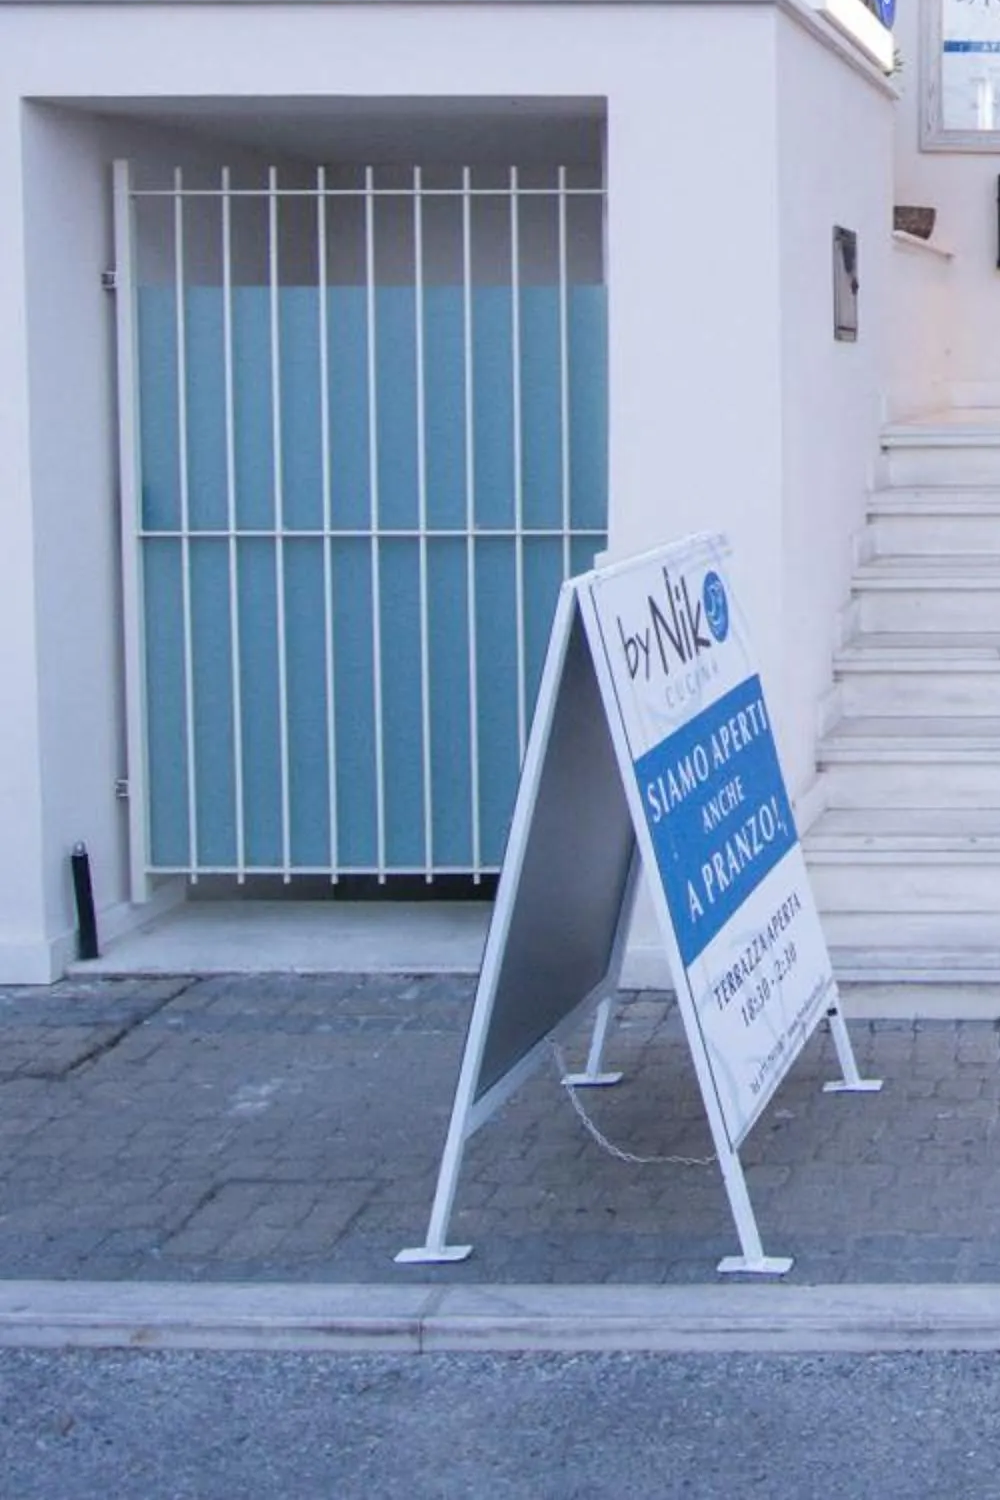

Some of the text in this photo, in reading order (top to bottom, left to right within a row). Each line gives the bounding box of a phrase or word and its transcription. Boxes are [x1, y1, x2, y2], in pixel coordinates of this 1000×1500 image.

[617, 615, 651, 682] by
[646, 698, 768, 823] SIAMO APERTI
[702, 775, 746, 834] ANCHE
[687, 879, 704, 923] A
[766, 891, 803, 948] APERTA
